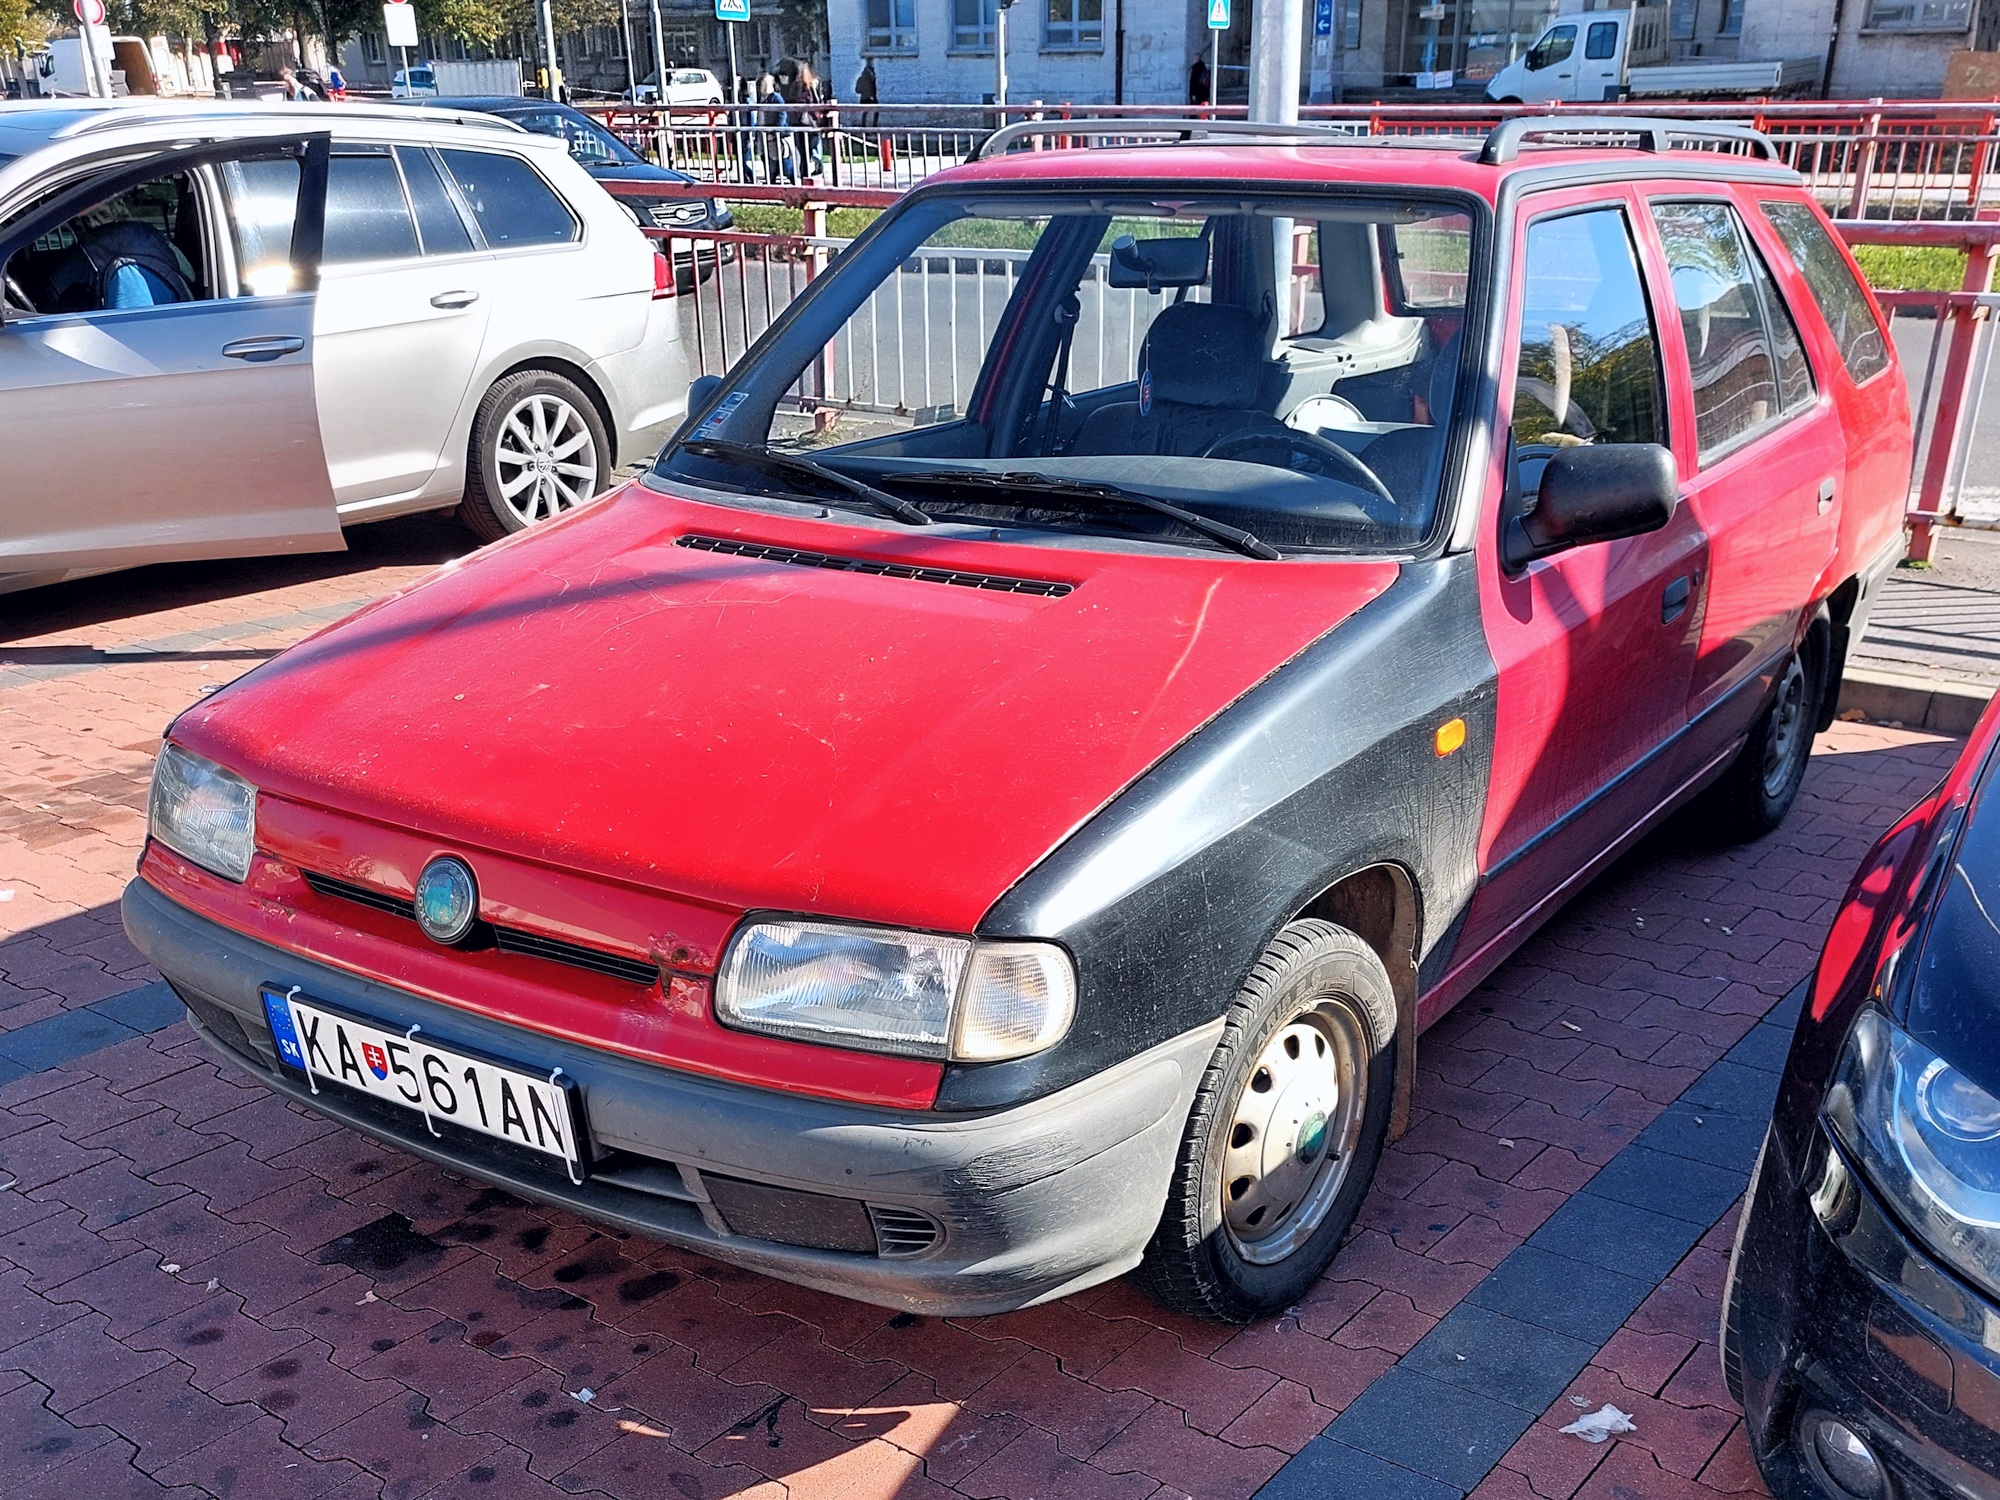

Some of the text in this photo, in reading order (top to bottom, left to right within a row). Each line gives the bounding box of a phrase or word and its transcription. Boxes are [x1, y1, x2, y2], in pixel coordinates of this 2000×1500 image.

[281, 1039, 300, 1058] SK
[1229, 995, 1292, 1104] POLARIS
[1364, 991, 1389, 1051] BARU
